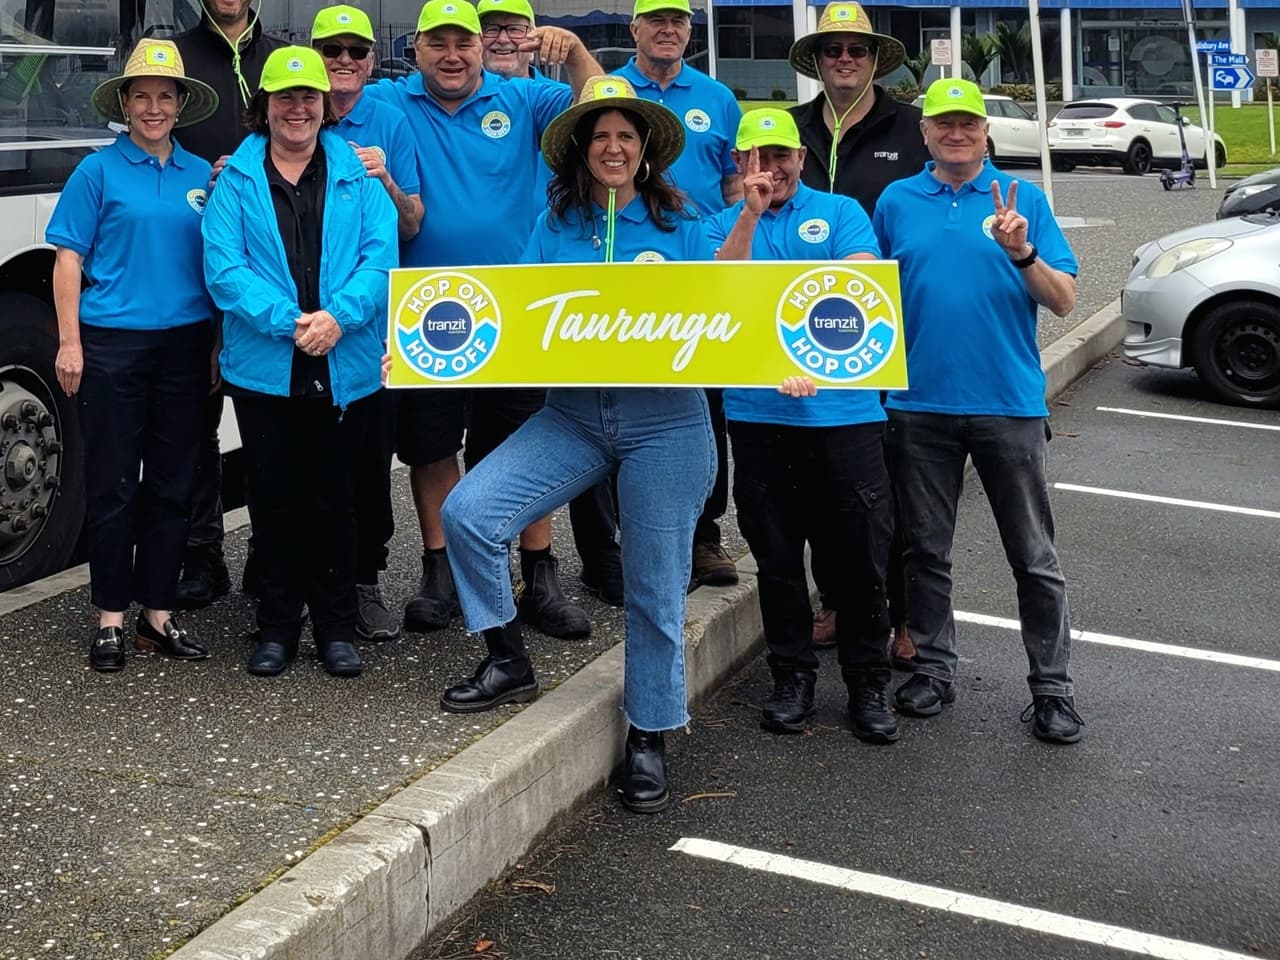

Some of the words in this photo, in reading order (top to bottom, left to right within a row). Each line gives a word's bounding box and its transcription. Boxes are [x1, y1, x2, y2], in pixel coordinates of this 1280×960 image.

[1214, 55, 1227, 63] The
[1228, 55, 1244, 63] Mall
[407, 279, 450, 314] HOP
[458, 283, 488, 312] ON
[789, 274, 837, 310] HOP
[846, 279, 882, 310] ON
[427, 318, 466, 331] tranzit
[525, 289, 742, 372] Tauranga
[814, 316, 859, 329] tranzit
[406, 339, 447, 374] HOP
[451, 338, 487, 372] OFF
[791, 337, 839, 374] HOP
[845, 337, 884, 374] OFF
